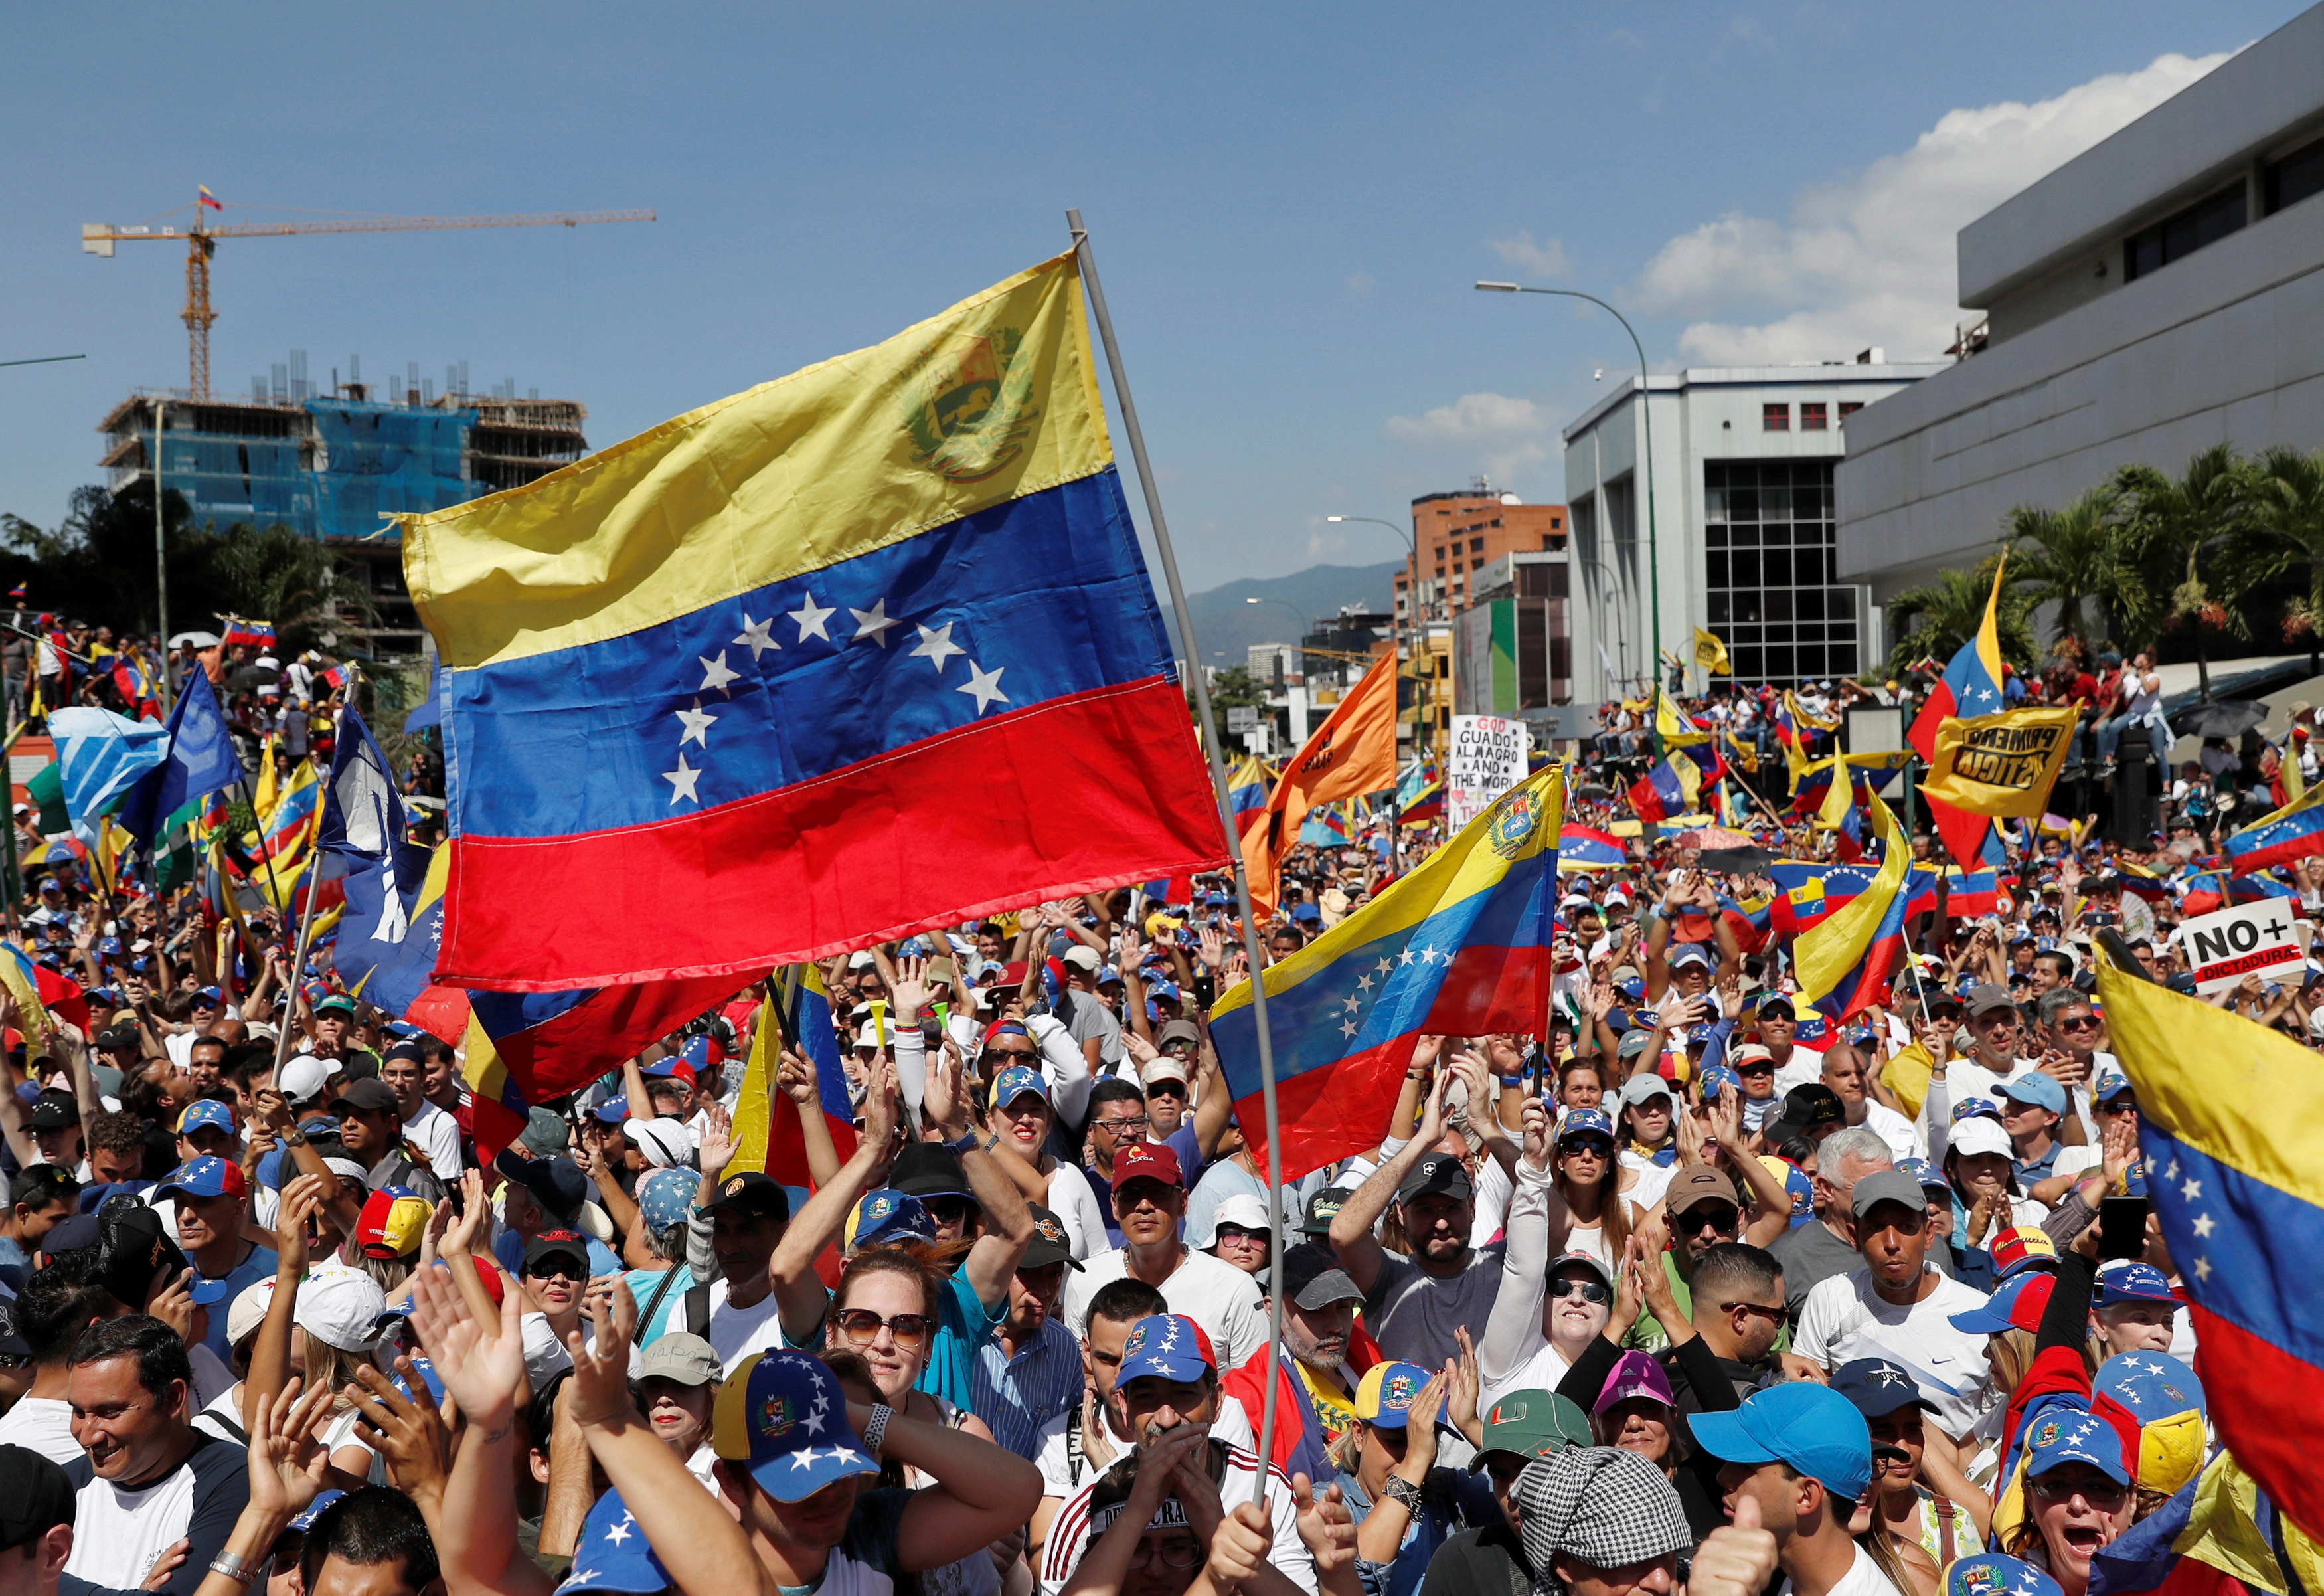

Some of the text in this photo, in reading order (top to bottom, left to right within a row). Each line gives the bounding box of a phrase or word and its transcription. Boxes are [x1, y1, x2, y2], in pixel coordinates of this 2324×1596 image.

[1477, 717, 1507, 733] GOD
[1461, 731, 1511, 748] GUAIDO
[1456, 745, 1518, 763] ALMAGRO
[1472, 760, 1499, 774] AND
[1452, 774, 1476, 787] THE
[2203, 947, 2295, 980] DICTADURA
